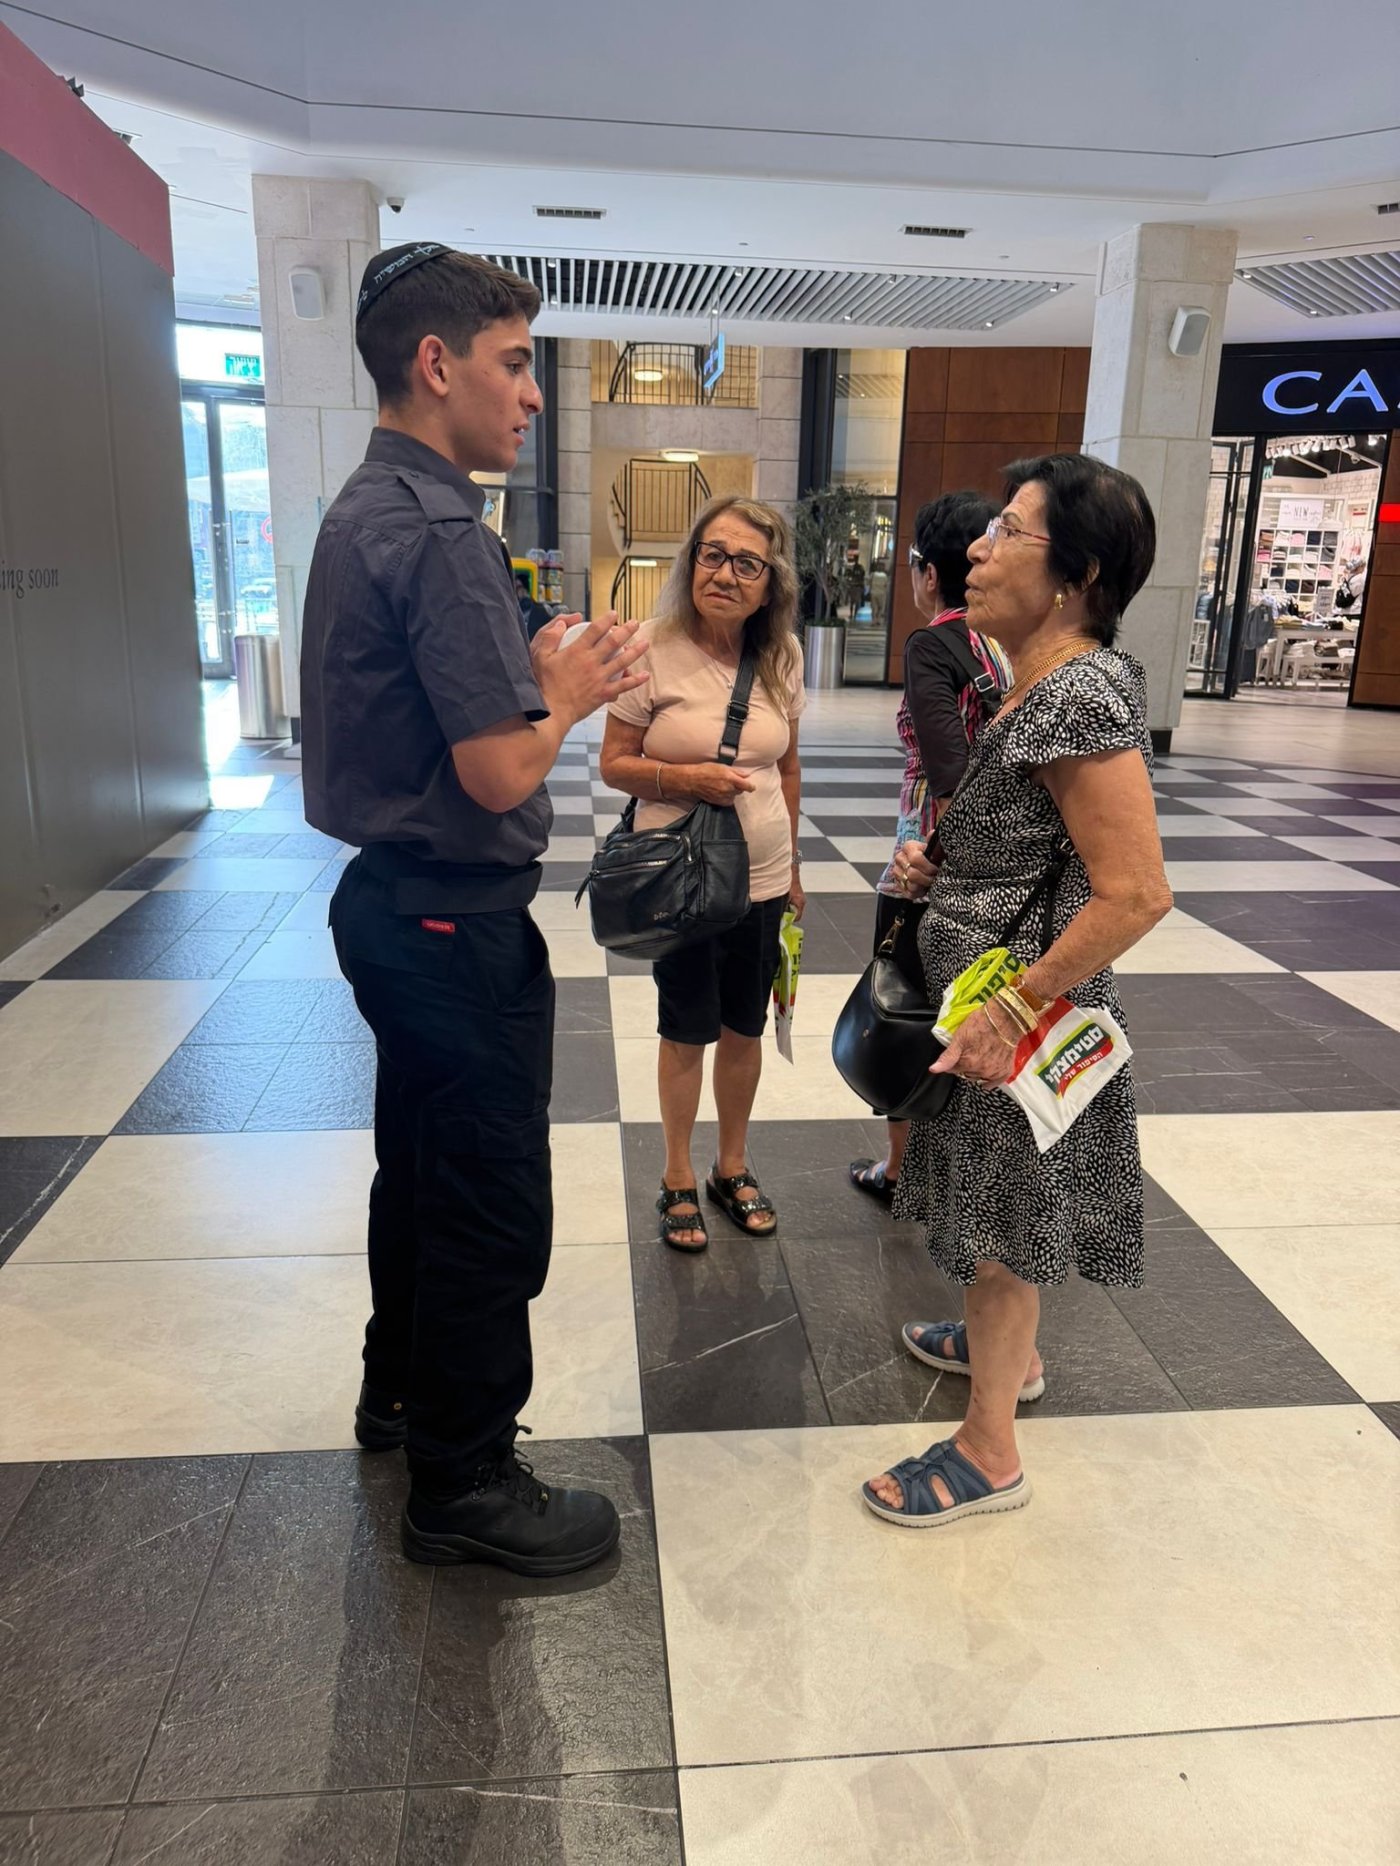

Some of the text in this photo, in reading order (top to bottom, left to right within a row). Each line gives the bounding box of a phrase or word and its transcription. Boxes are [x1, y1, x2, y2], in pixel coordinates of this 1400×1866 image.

[373, 253, 414, 285] המשיח
[1261, 368, 1400, 415] CA
[0, 559, 59, 600] ing soon
[1044, 1025, 1105, 1086] סטימצקי
[1063, 1051, 1104, 1082] הסיפור שלי
